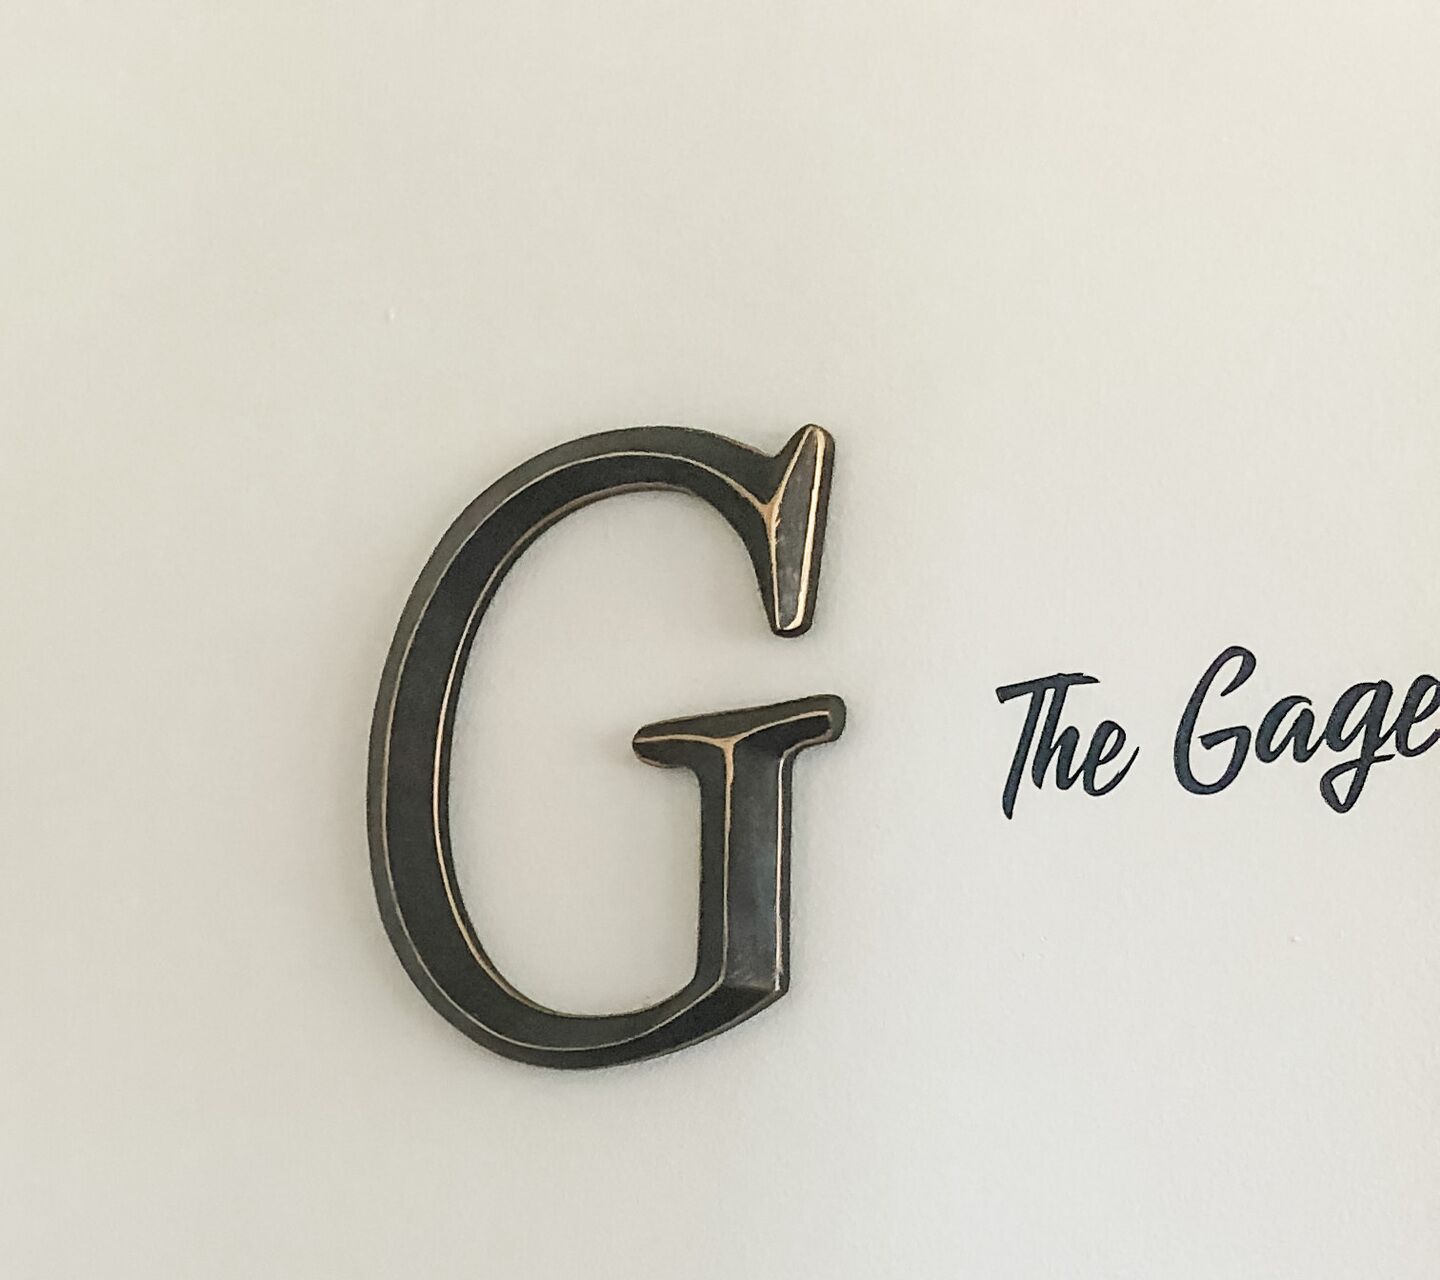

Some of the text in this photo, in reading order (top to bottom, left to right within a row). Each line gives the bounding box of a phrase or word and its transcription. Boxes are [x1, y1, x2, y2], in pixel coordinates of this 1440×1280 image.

[366, 424, 846, 1070] G
[996, 646, 1440, 819] The Gage
